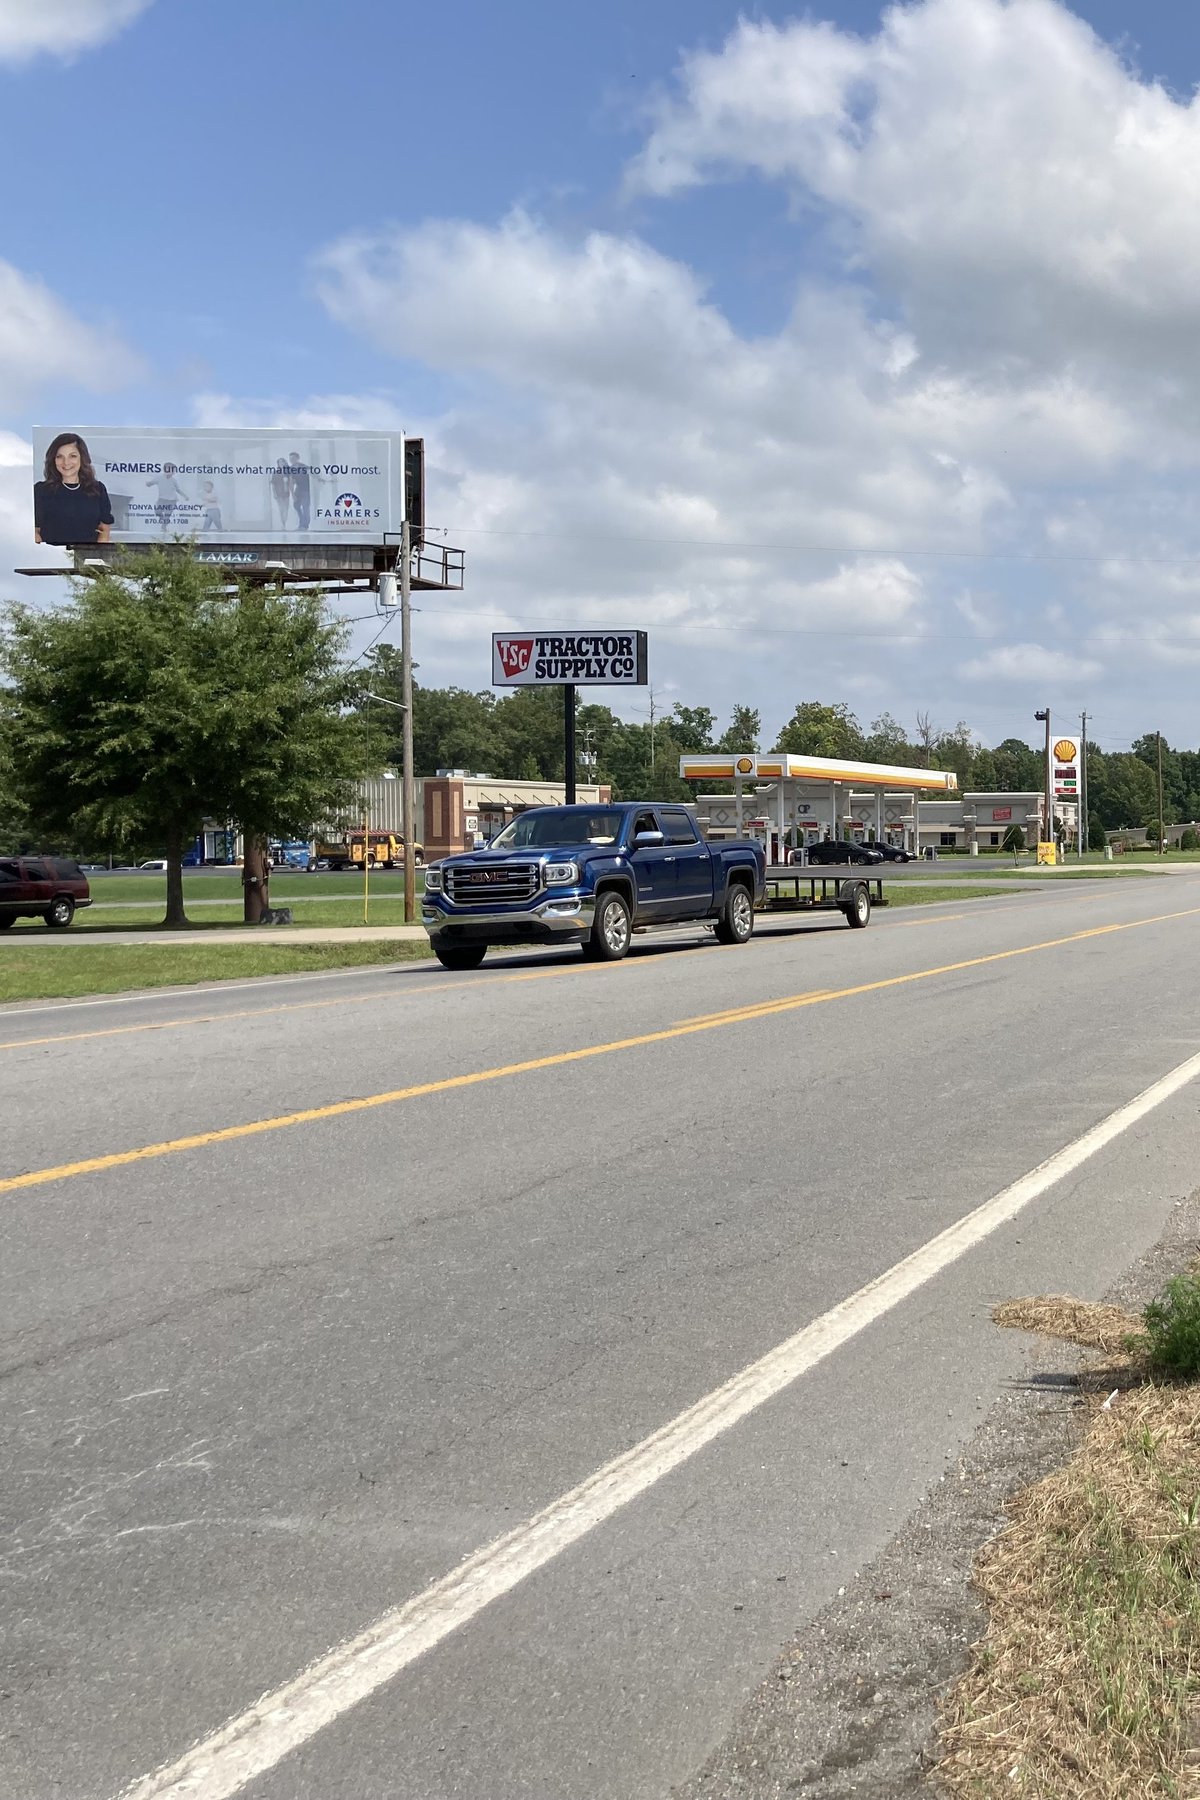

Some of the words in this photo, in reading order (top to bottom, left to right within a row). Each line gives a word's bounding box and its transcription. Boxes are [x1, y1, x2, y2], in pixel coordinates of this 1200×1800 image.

[105, 462, 162, 474] FARMERS
[164, 463, 234, 475] understands
[236, 464, 263, 475] what
[265, 464, 307, 475] matters
[310, 465, 321, 475] to
[323, 464, 349, 475] YOU
[351, 465, 382, 475] most.
[128, 503, 153, 511] TONYA
[317, 509, 380, 518] FARMERS
[198, 552, 253, 562] LAMAR
[535, 636, 633, 658] TRACTOR
[500, 641, 528, 671] TSC
[535, 658, 609, 679] SUPPLY
[469, 871, 509, 883] GMC
